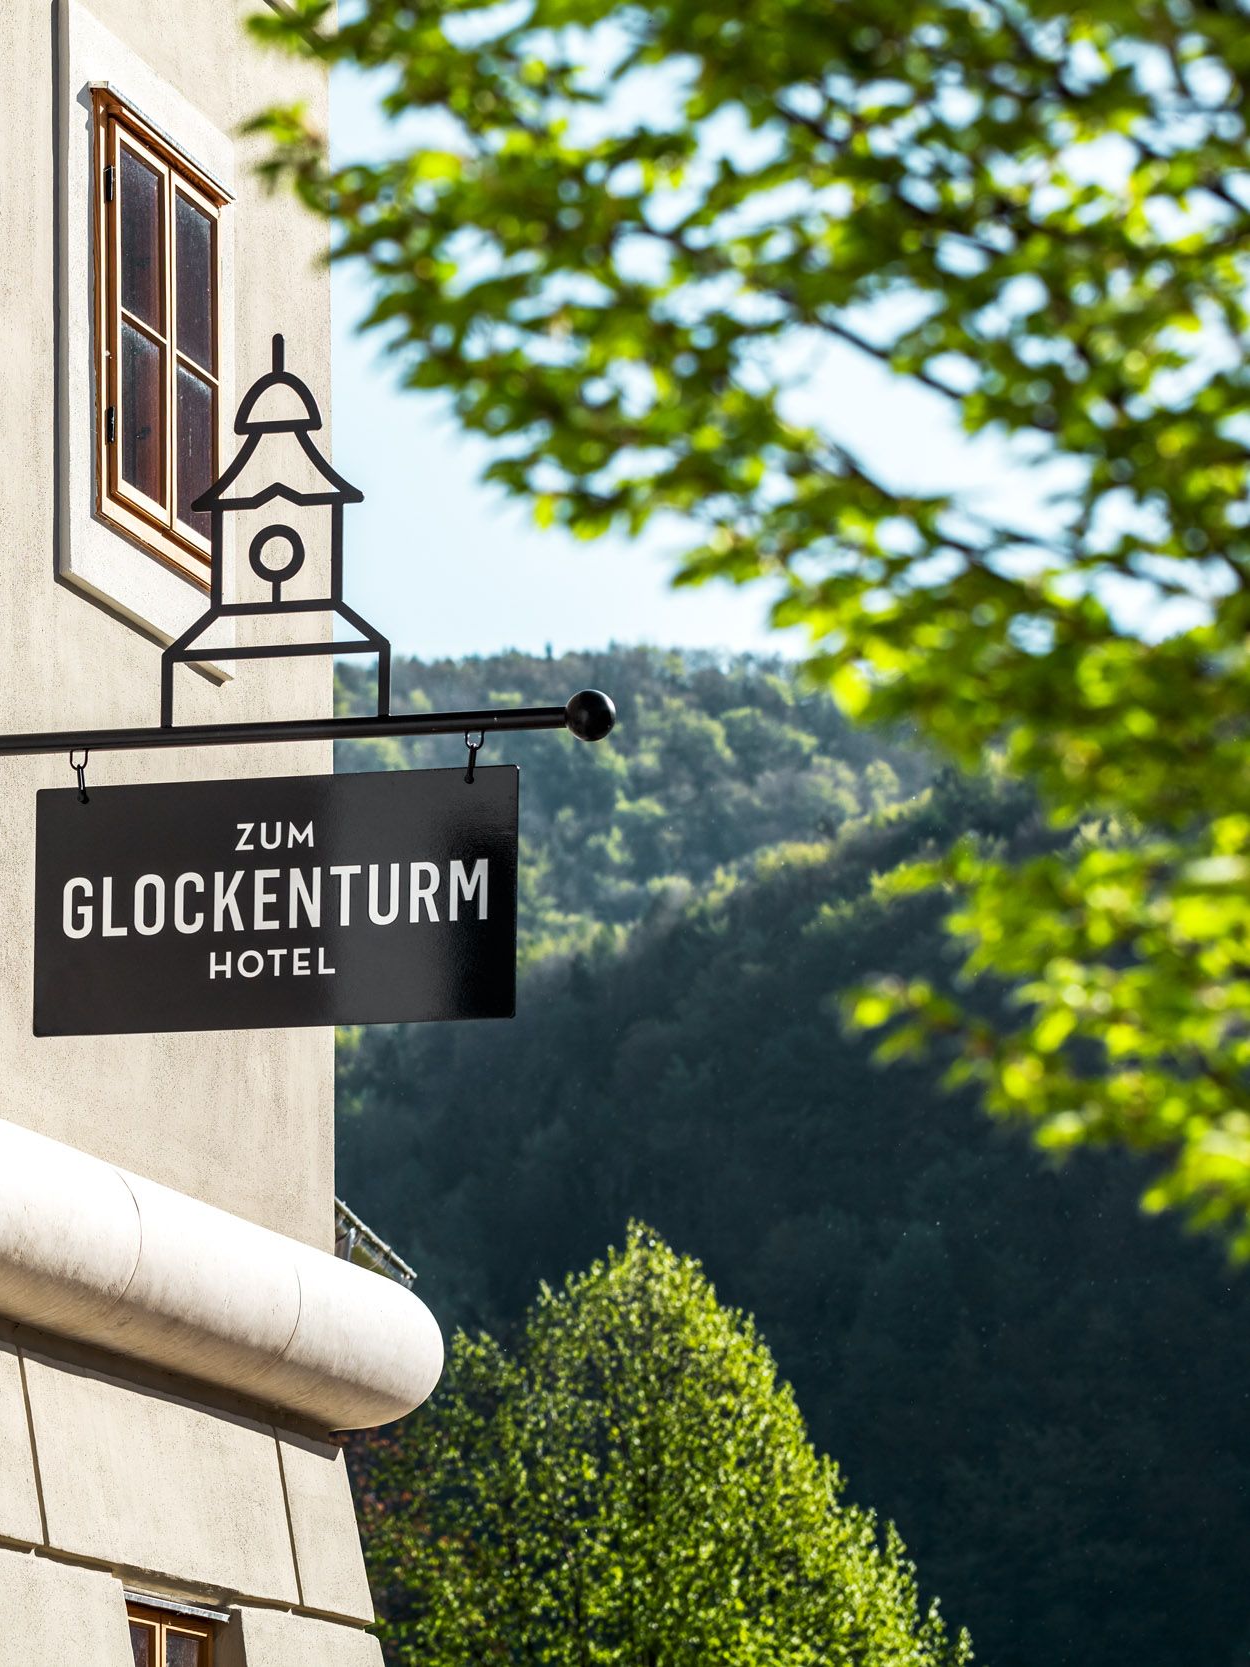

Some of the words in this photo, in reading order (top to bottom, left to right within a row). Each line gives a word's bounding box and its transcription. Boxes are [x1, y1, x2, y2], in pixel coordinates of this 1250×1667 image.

[234, 820, 315, 851] ZUM
[62, 857, 489, 939] GLOCKENTURM
[209, 947, 336, 980] HOTEL
